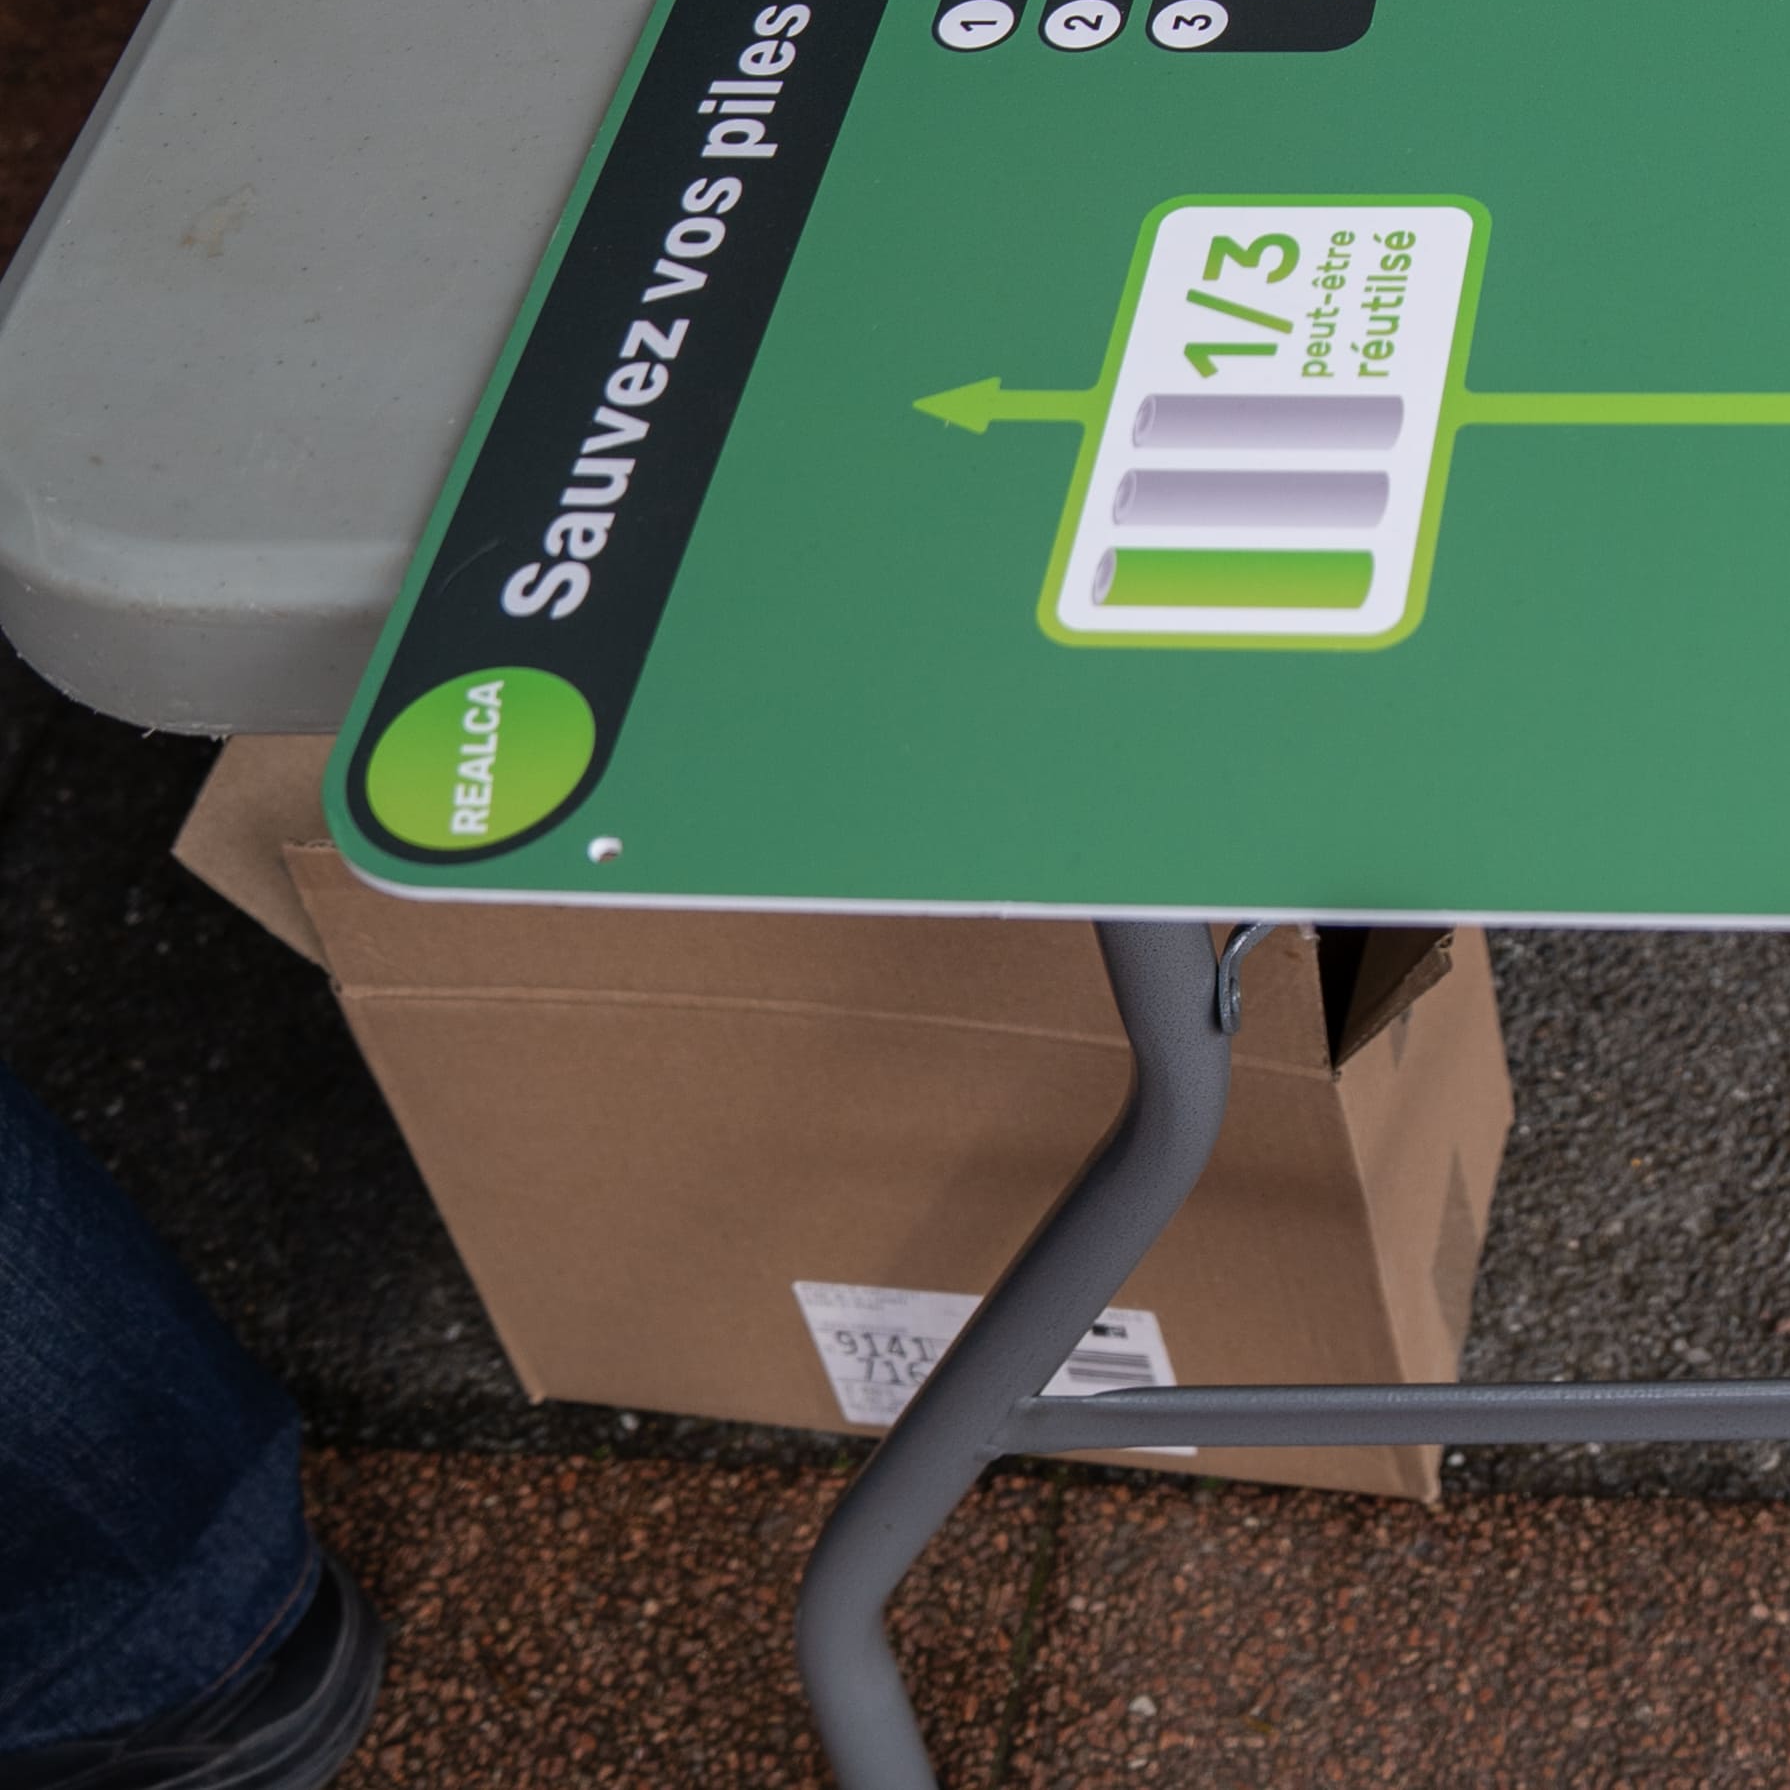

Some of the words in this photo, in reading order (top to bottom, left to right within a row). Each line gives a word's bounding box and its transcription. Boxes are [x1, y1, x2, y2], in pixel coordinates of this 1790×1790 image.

[960, 19, 998, 34] 1
[1062, 13, 1104, 33] 2
[1171, 14, 1214, 32] 3
[502, 317, 692, 620] Sauvez
[641, 172, 742, 305] vos
[697, 0, 813, 159] piles
[1183, 232, 1301, 379] 1/3
[1300, 229, 1356, 378] peut-être
[1350, 229, 1417, 378] réutilsé
[450, 678, 505, 838] REALCA
